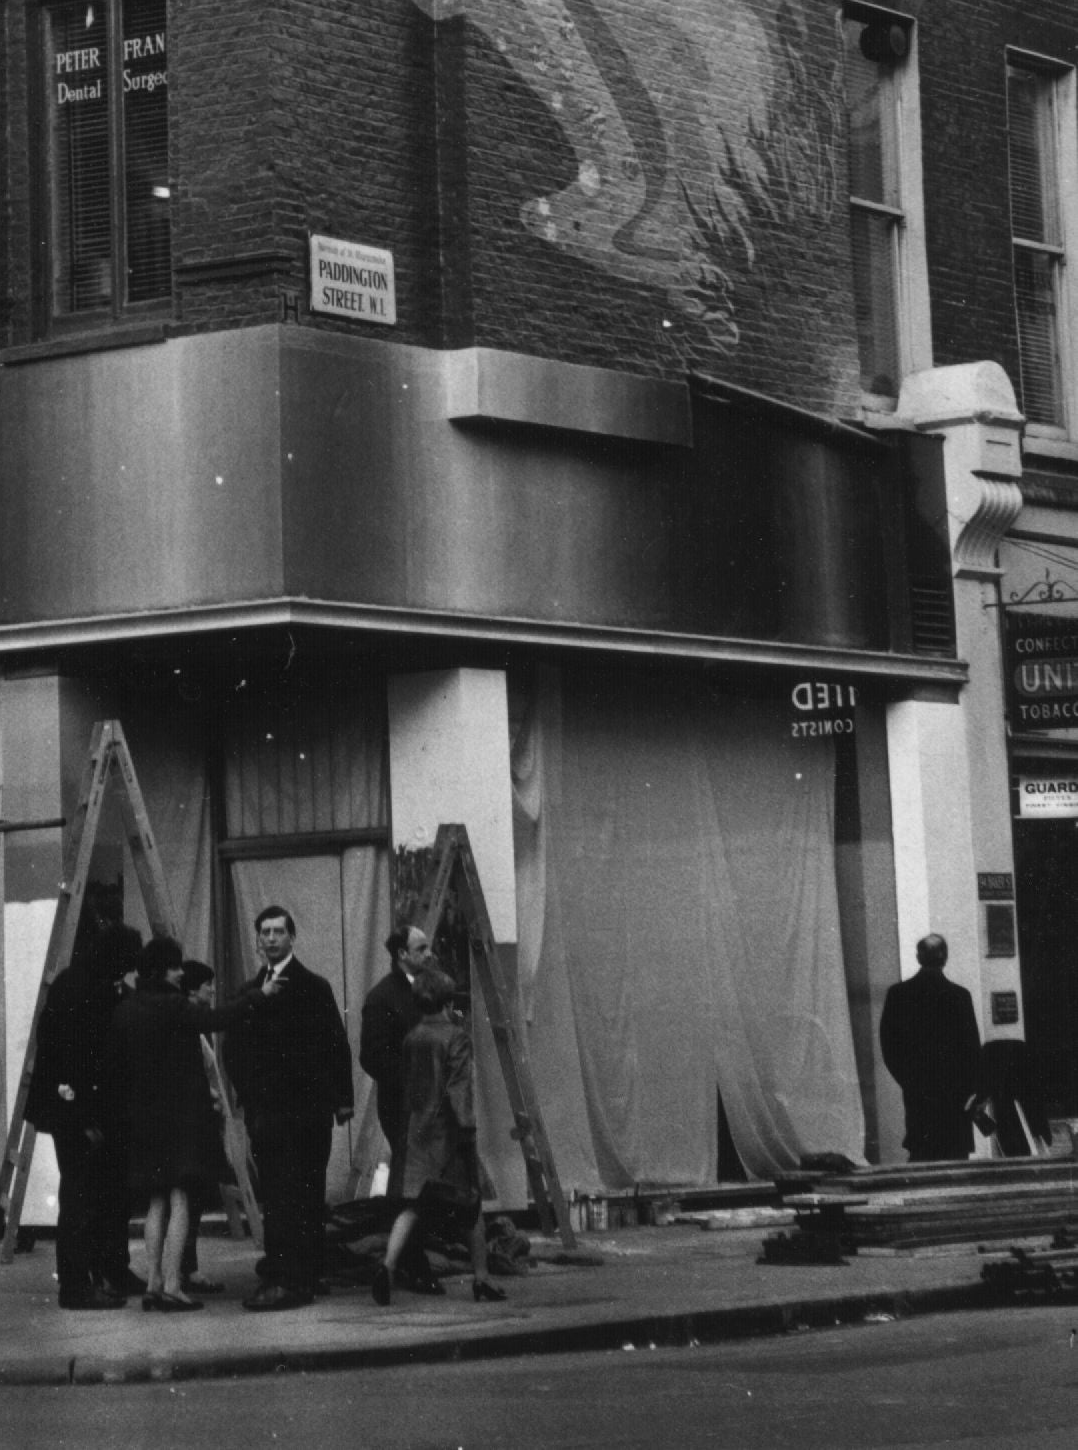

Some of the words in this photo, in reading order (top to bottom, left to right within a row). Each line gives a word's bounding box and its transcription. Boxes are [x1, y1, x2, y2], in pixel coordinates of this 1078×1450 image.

[56, 47, 101, 74] PETER
[58, 79, 101, 105] Dental
[319, 258, 388, 291] PADDINGTON
[1021, 663, 1078, 692] UNI
